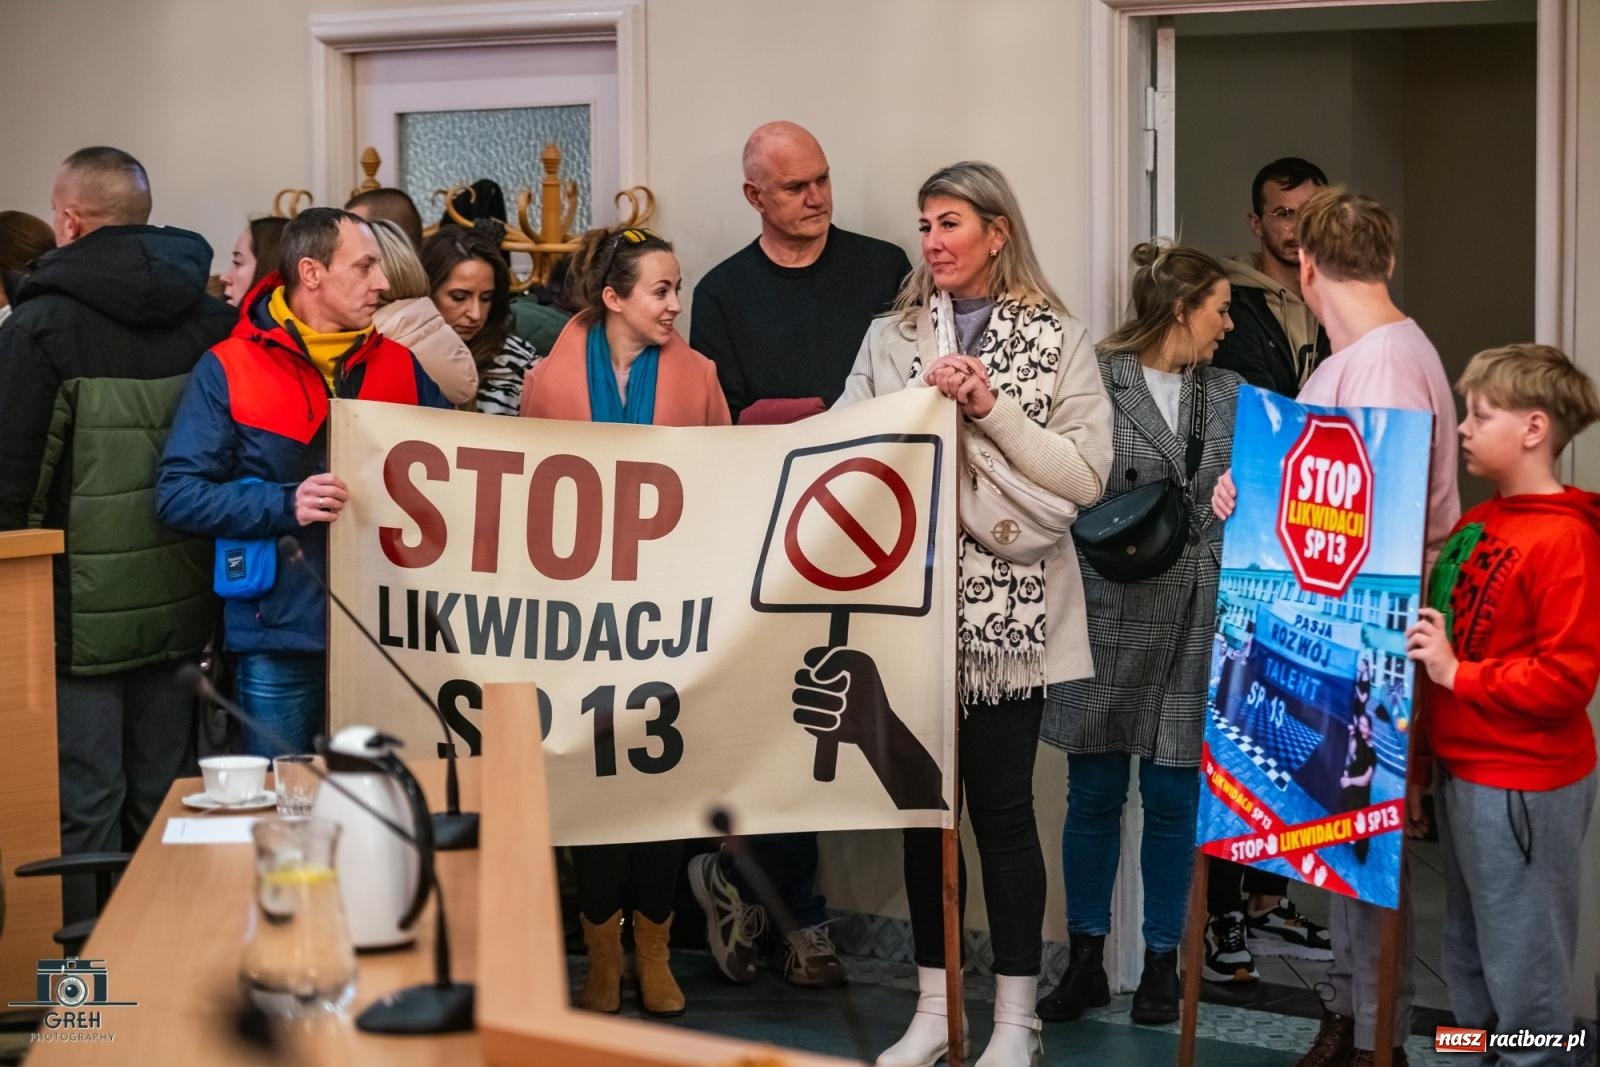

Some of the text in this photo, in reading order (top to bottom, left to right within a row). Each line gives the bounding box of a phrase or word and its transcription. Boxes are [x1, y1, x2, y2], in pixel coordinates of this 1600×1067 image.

[1298, 455, 1362, 509] STOP
[379, 440, 684, 581] STOP
[1288, 500, 1364, 537] LIKWIDACJI
[379, 586, 713, 662] LIKWIDACJI
[1294, 614, 1333, 639] PASJA
[1265, 658, 1321, 701] TALENT
[437, 679, 684, 777] S 13
[1247, 681, 1285, 729] SP 13
[1231, 838, 1264, 861] STOP
[1280, 818, 1352, 852] LIKWIDACJI
